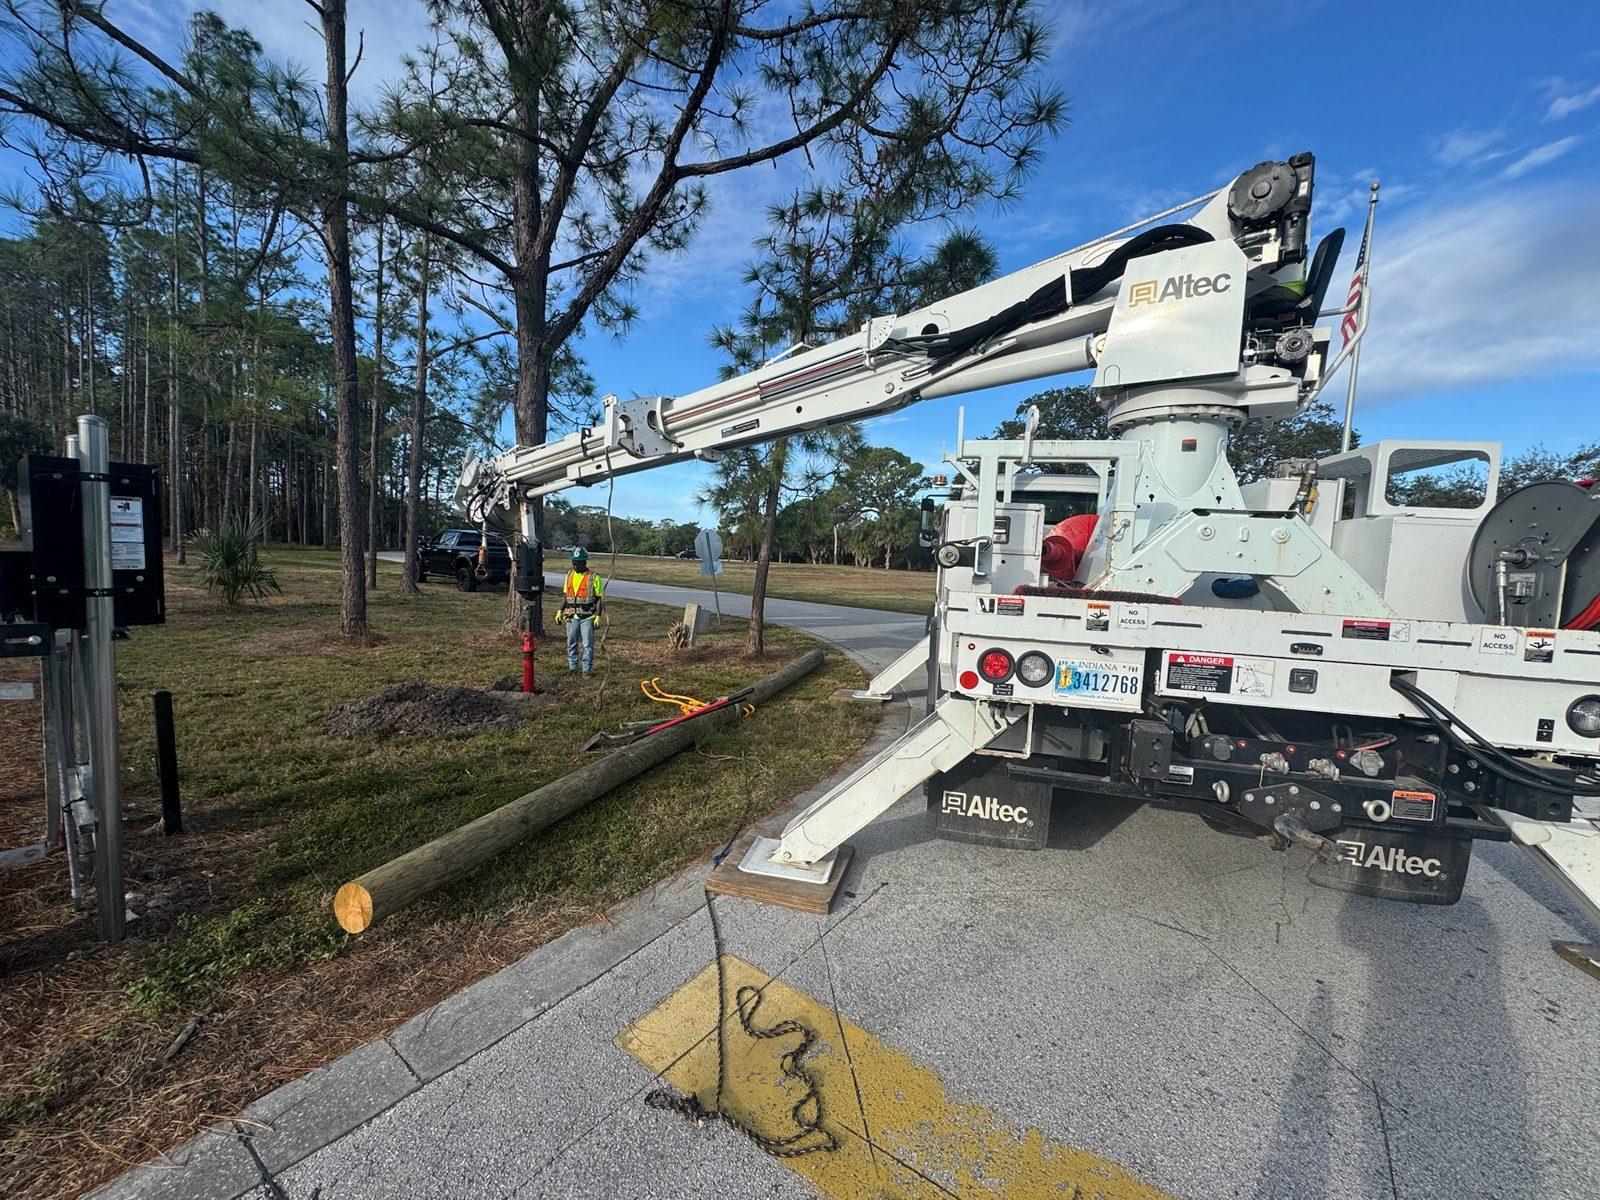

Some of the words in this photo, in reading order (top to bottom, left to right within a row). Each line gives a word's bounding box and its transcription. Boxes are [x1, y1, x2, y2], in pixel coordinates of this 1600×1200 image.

[1158, 273, 1231, 303] Altec
[1482, 642, 1514, 650] ACCESS
[1078, 661, 1118, 671] INDIANA
[1189, 656, 1224, 664] DANGER
[1073, 671, 1139, 695] 3412768
[966, 795, 1028, 824] Altec
[1363, 845, 1441, 877] Altec
